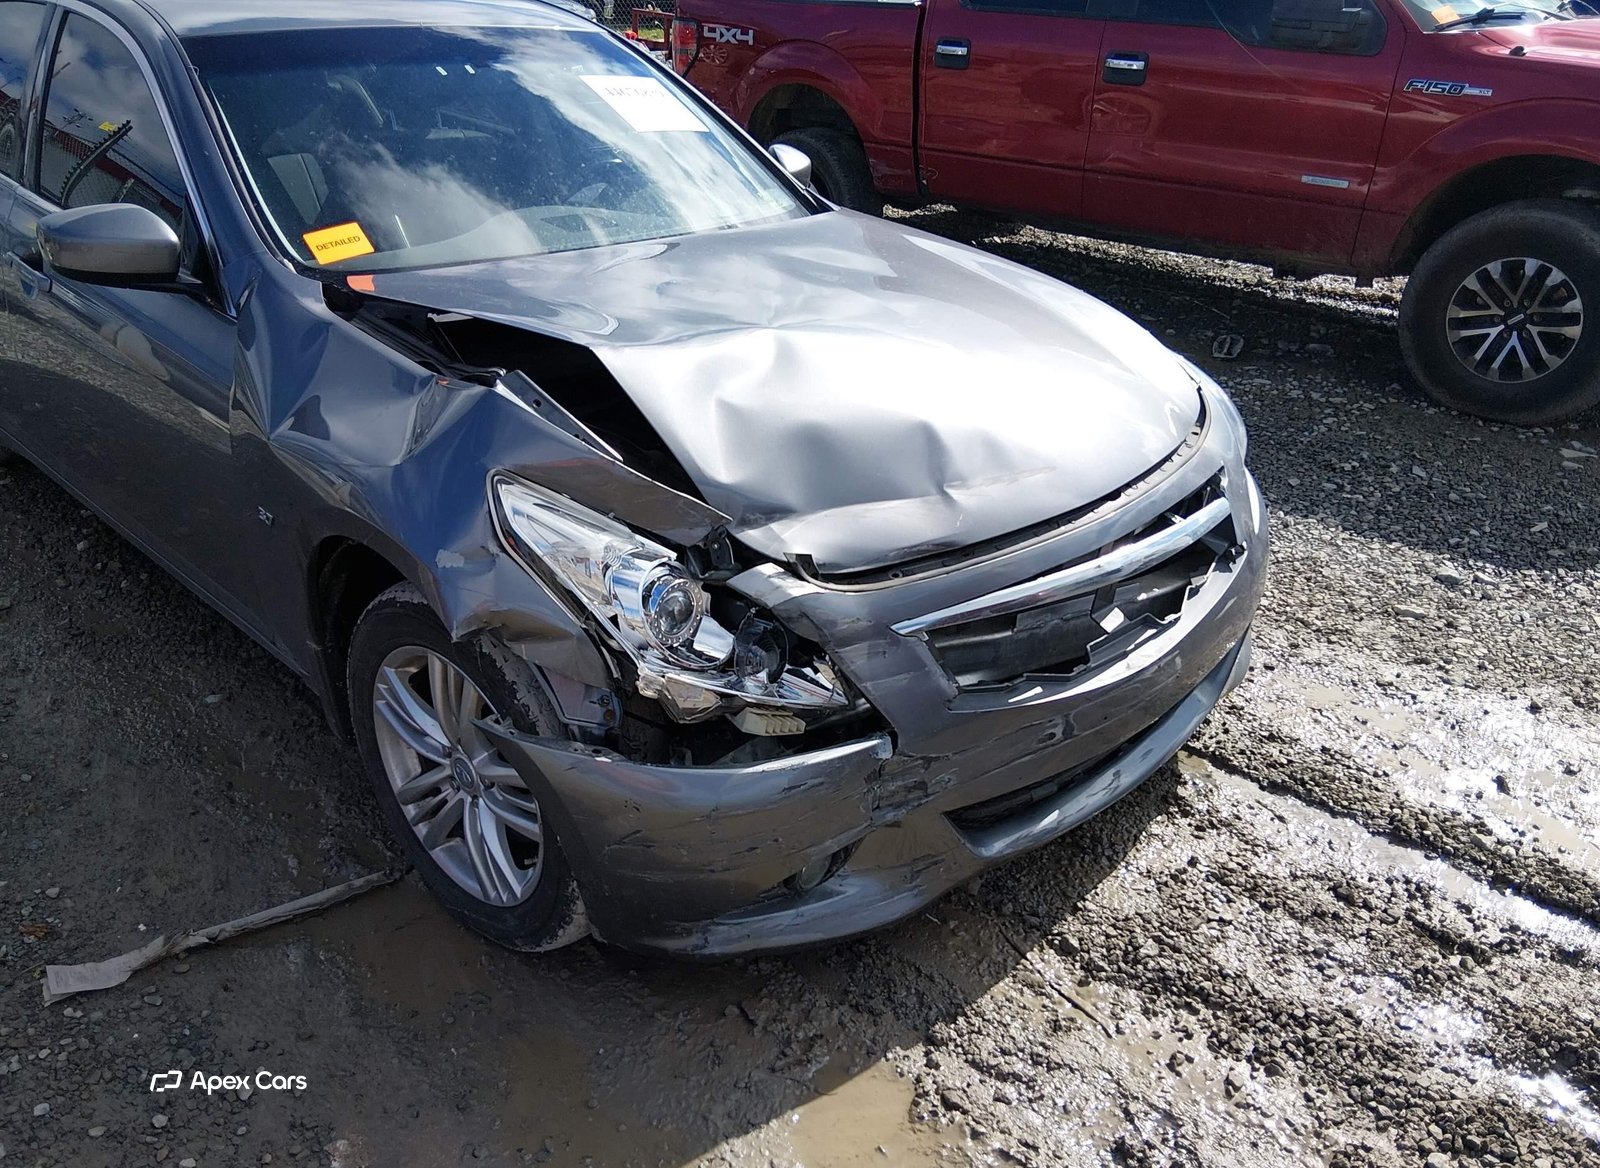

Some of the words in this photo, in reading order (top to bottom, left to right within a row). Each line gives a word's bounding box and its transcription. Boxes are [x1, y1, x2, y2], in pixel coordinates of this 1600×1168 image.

[703, 26, 754, 46] 4X4
[1403, 79, 1468, 97] F-150
[316, 236, 361, 251] DETAILED
